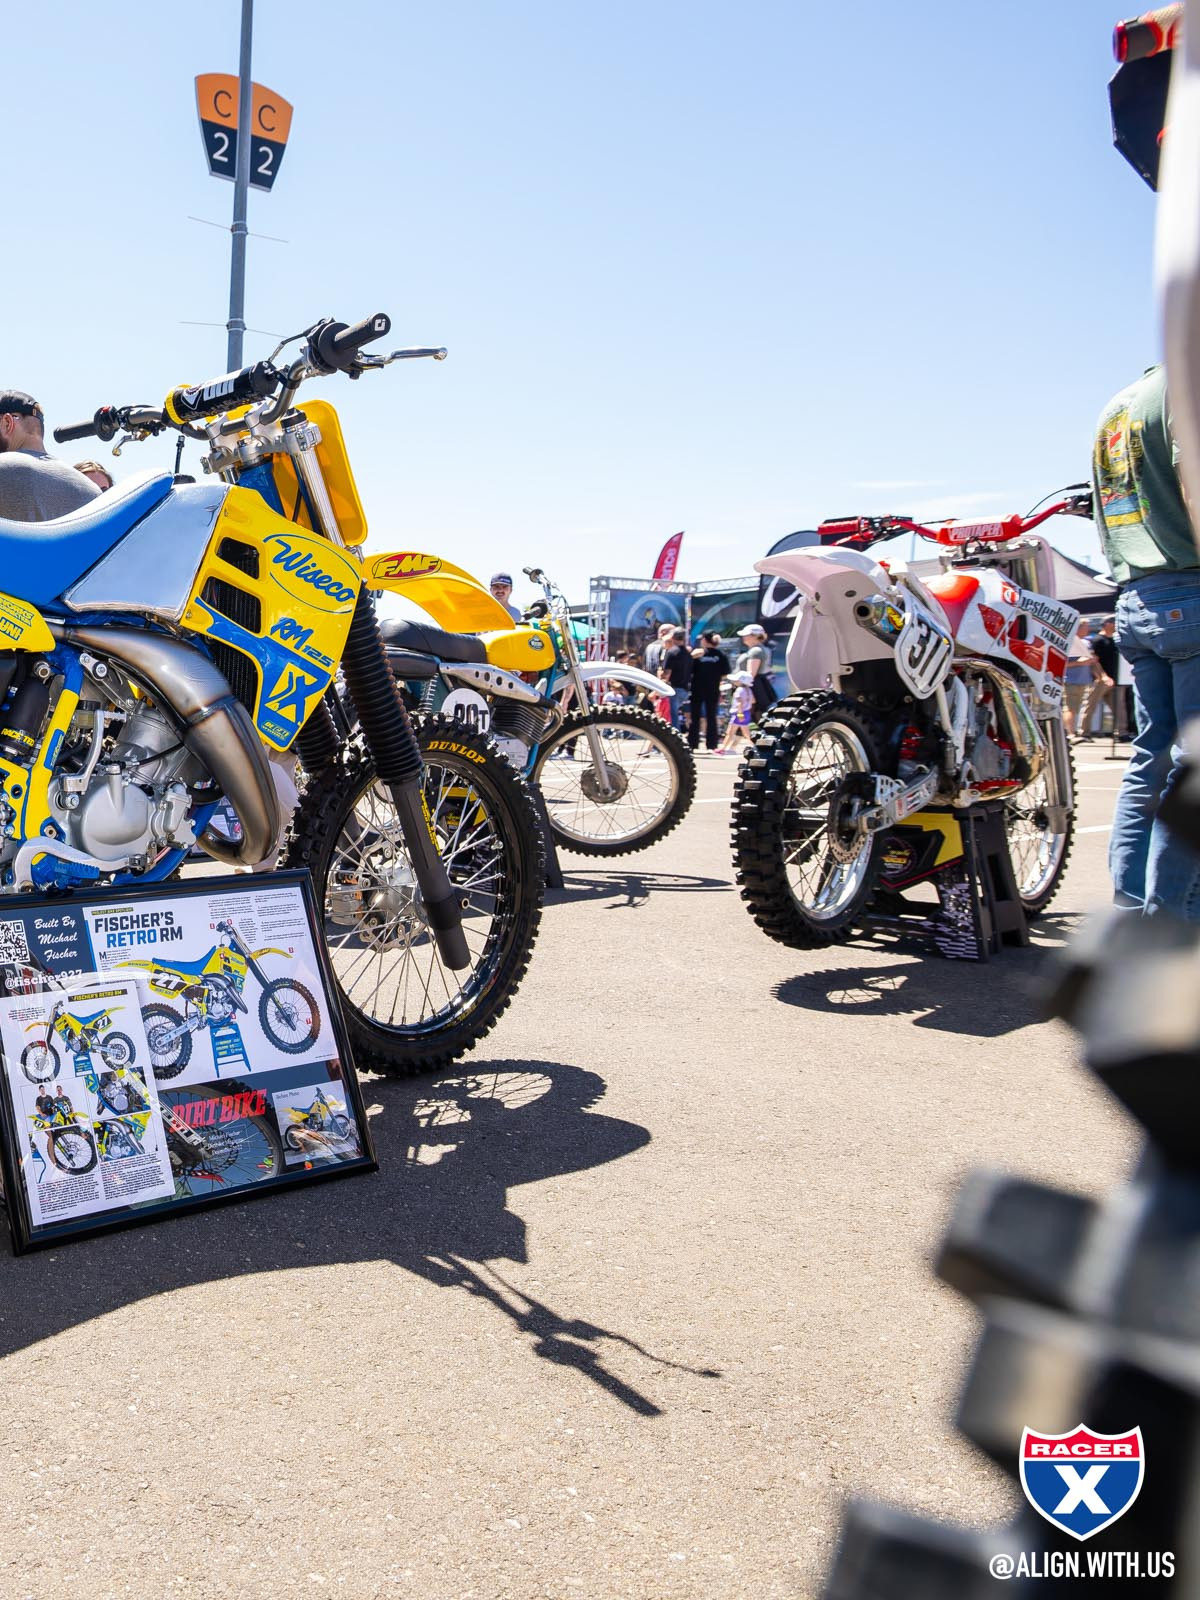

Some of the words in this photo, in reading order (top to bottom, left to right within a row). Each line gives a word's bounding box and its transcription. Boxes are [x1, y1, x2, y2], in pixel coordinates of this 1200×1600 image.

[213, 90, 232, 118] C
[258, 104, 276, 132] C
[213, 132, 229, 163] 2
[257, 146, 274, 176] 2
[272, 539, 356, 603] Wiseco
[373, 554, 440, 578] FMF
[270, 616, 314, 650] RM
[302, 645, 335, 668] 125
[1042, 681, 1062, 699] elf
[427, 740, 487, 764] DUNLOP
[33, 918, 60, 930] Built
[61, 915, 77, 929] By
[94, 911, 175, 934] FISCHER’S
[37, 931, 79, 946] Michael
[106, 928, 158, 948] RETRO
[159, 926, 184, 943] RM
[43, 948, 78, 962] Fischer
[4, 969, 83, 990] @fischer927
[97, 1017, 109, 1030] 27
[219, 1088, 268, 1123] BIKE
